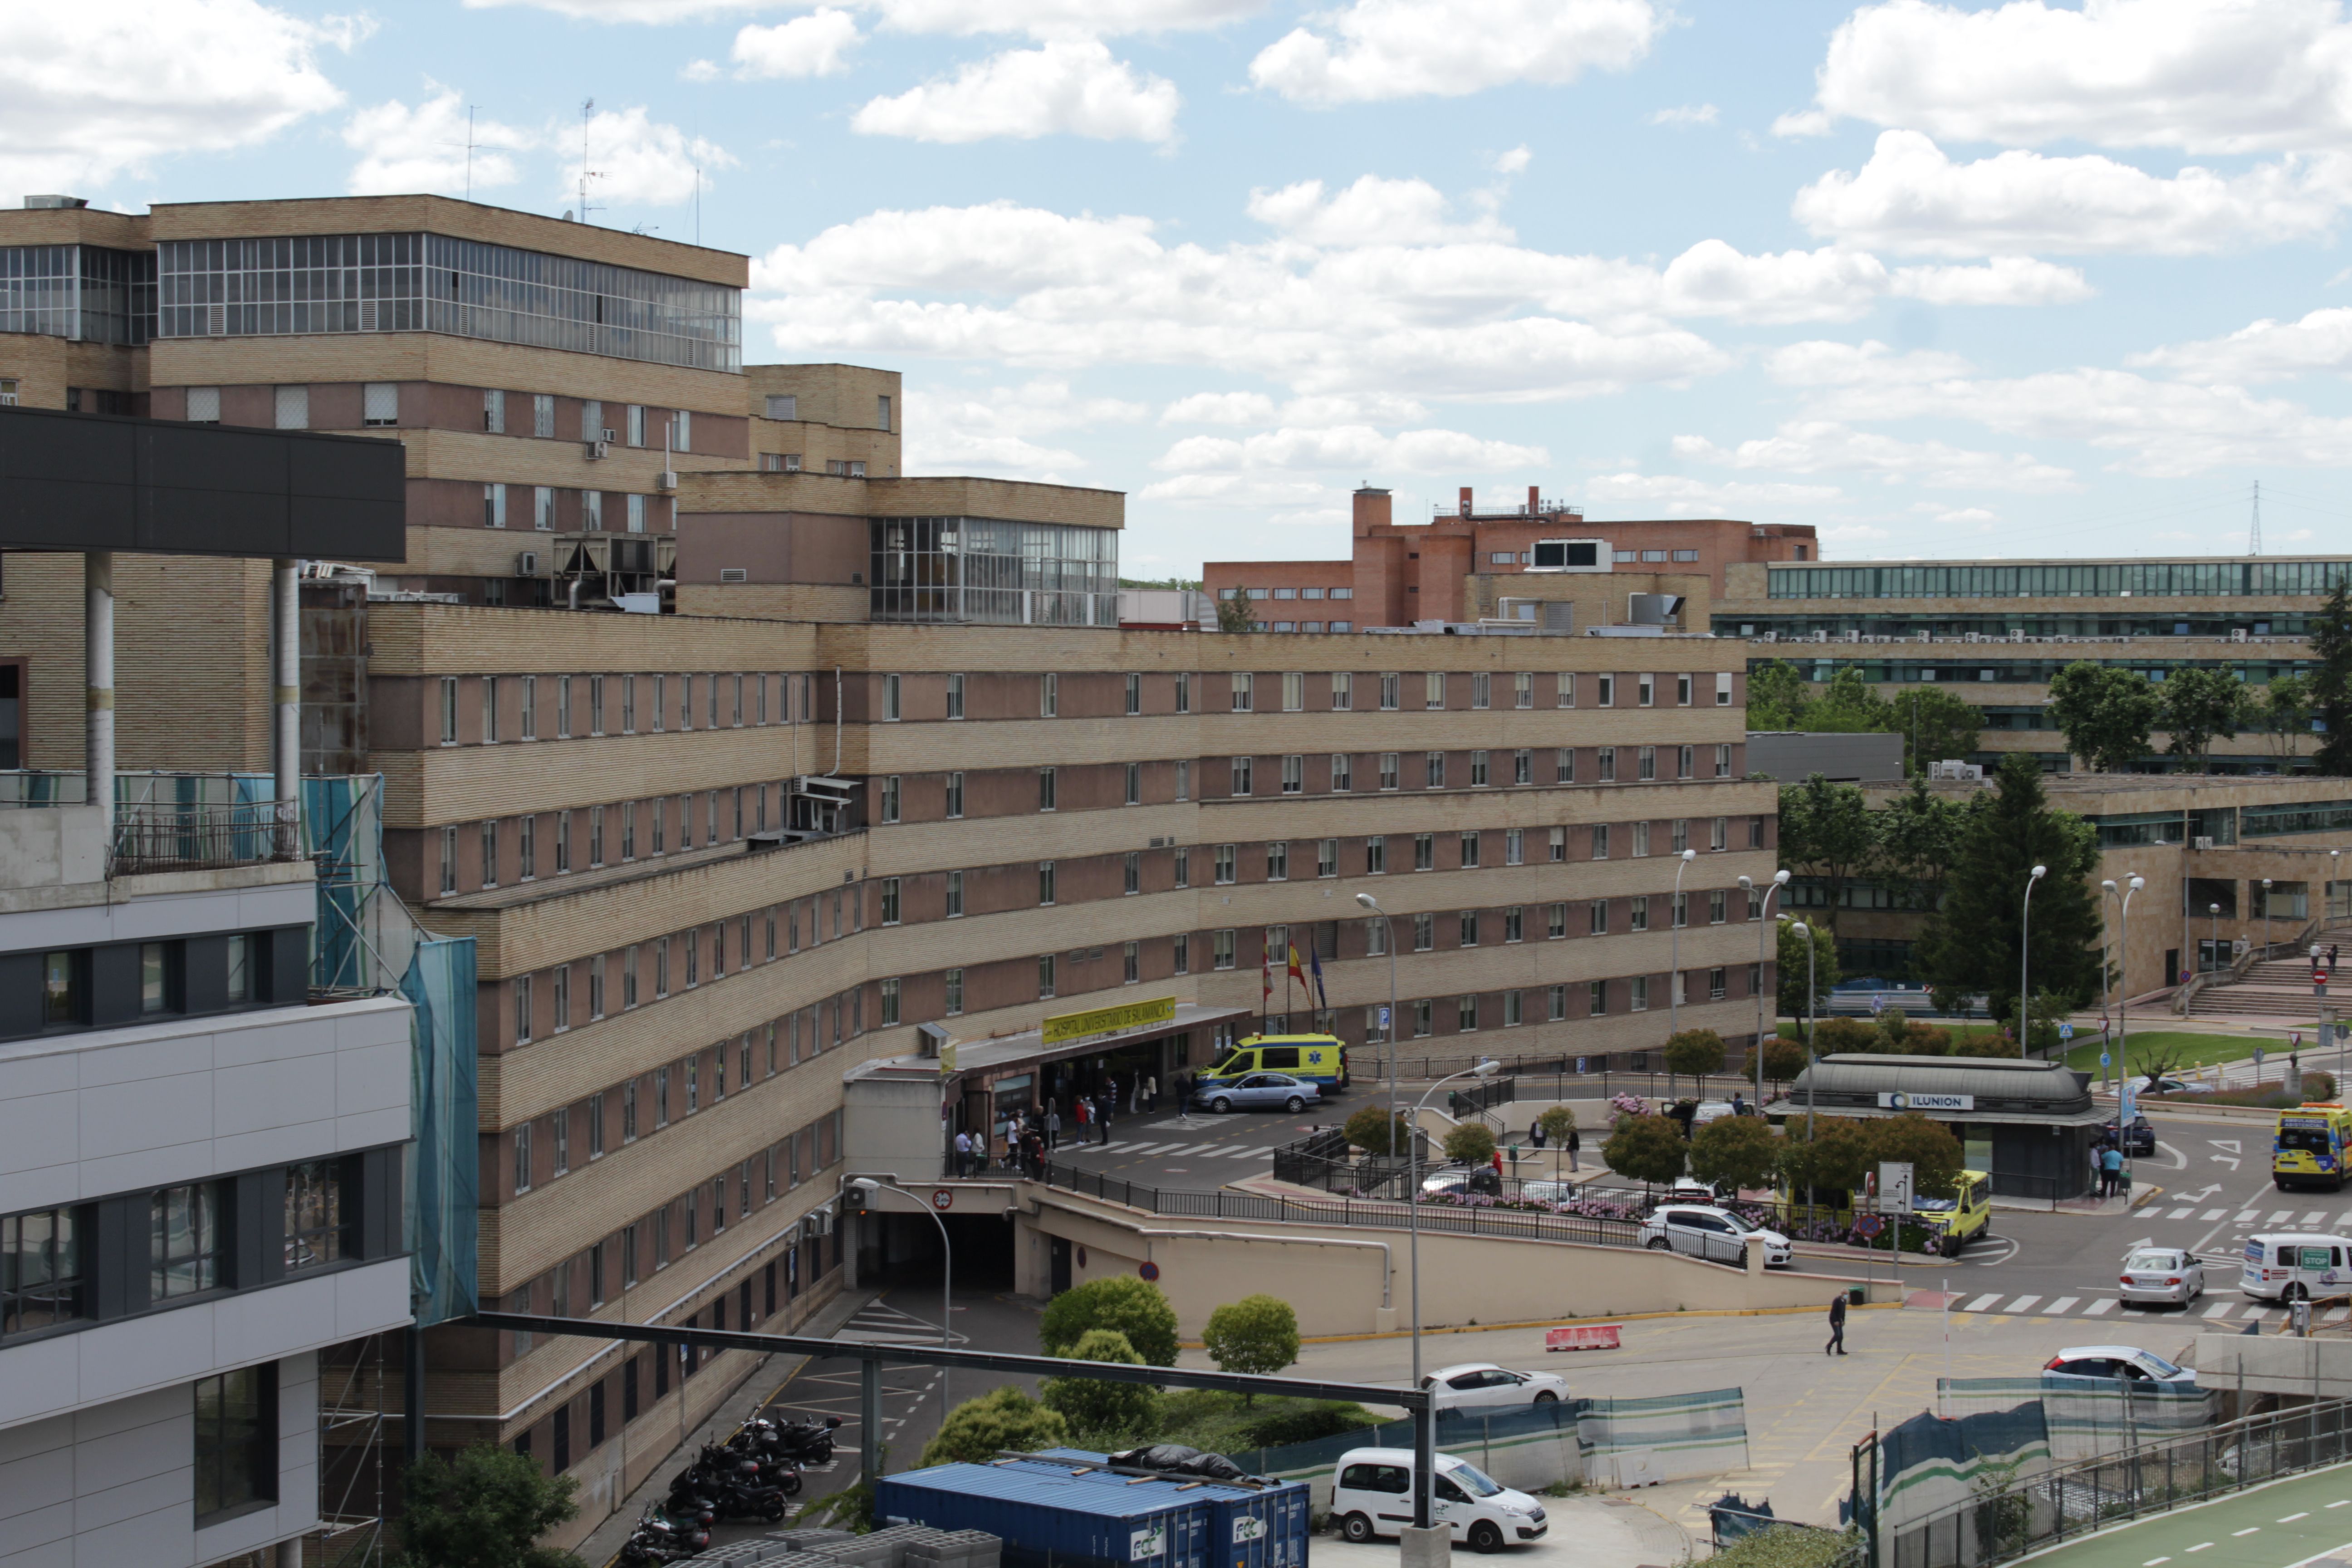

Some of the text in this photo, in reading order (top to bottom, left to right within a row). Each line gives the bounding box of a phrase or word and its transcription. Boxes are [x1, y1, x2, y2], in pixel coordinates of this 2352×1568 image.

[1054, 1019, 1080, 1038] HOSPITAL
[1081, 1010, 1123, 1033] UNIVERSITARIO
[1124, 1009, 1131, 1024] DE
[1132, 1003, 1166, 1023] SALAMANCA
[1912, 1096, 1961, 1107] ILUNION
[1434, 1507, 1446, 1515] CC
[1236, 1521, 1257, 1540] FCC
[1133, 1536, 1156, 1558] FCC
